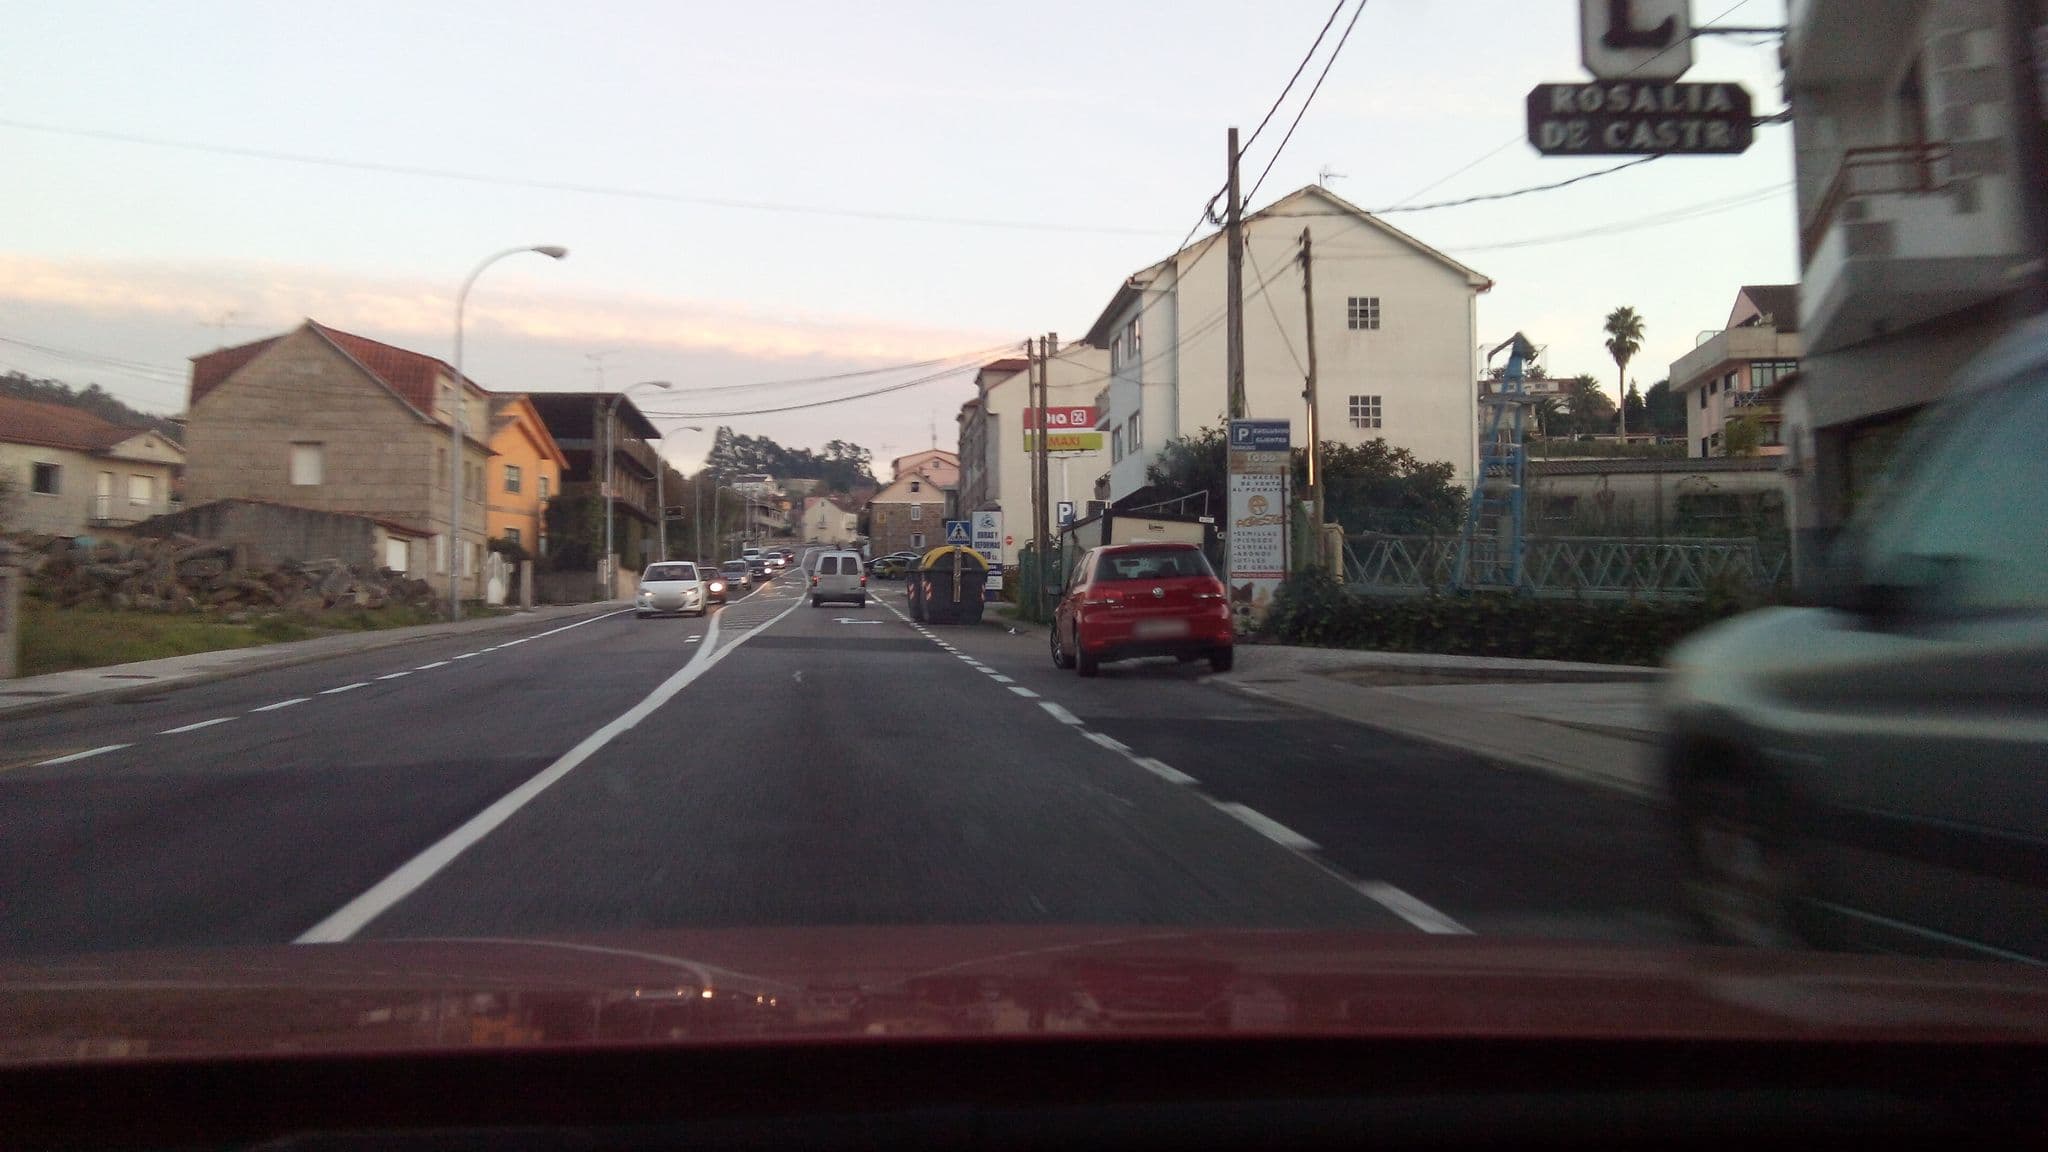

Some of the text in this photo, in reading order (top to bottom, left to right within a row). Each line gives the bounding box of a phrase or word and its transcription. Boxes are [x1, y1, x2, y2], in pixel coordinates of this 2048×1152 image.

[1551, 86, 1734, 112] ROSALIA
[1540, 119, 1744, 149] DE CASTR
[1238, 427, 1249, 441] P
[1059, 503, 1072, 523] P
